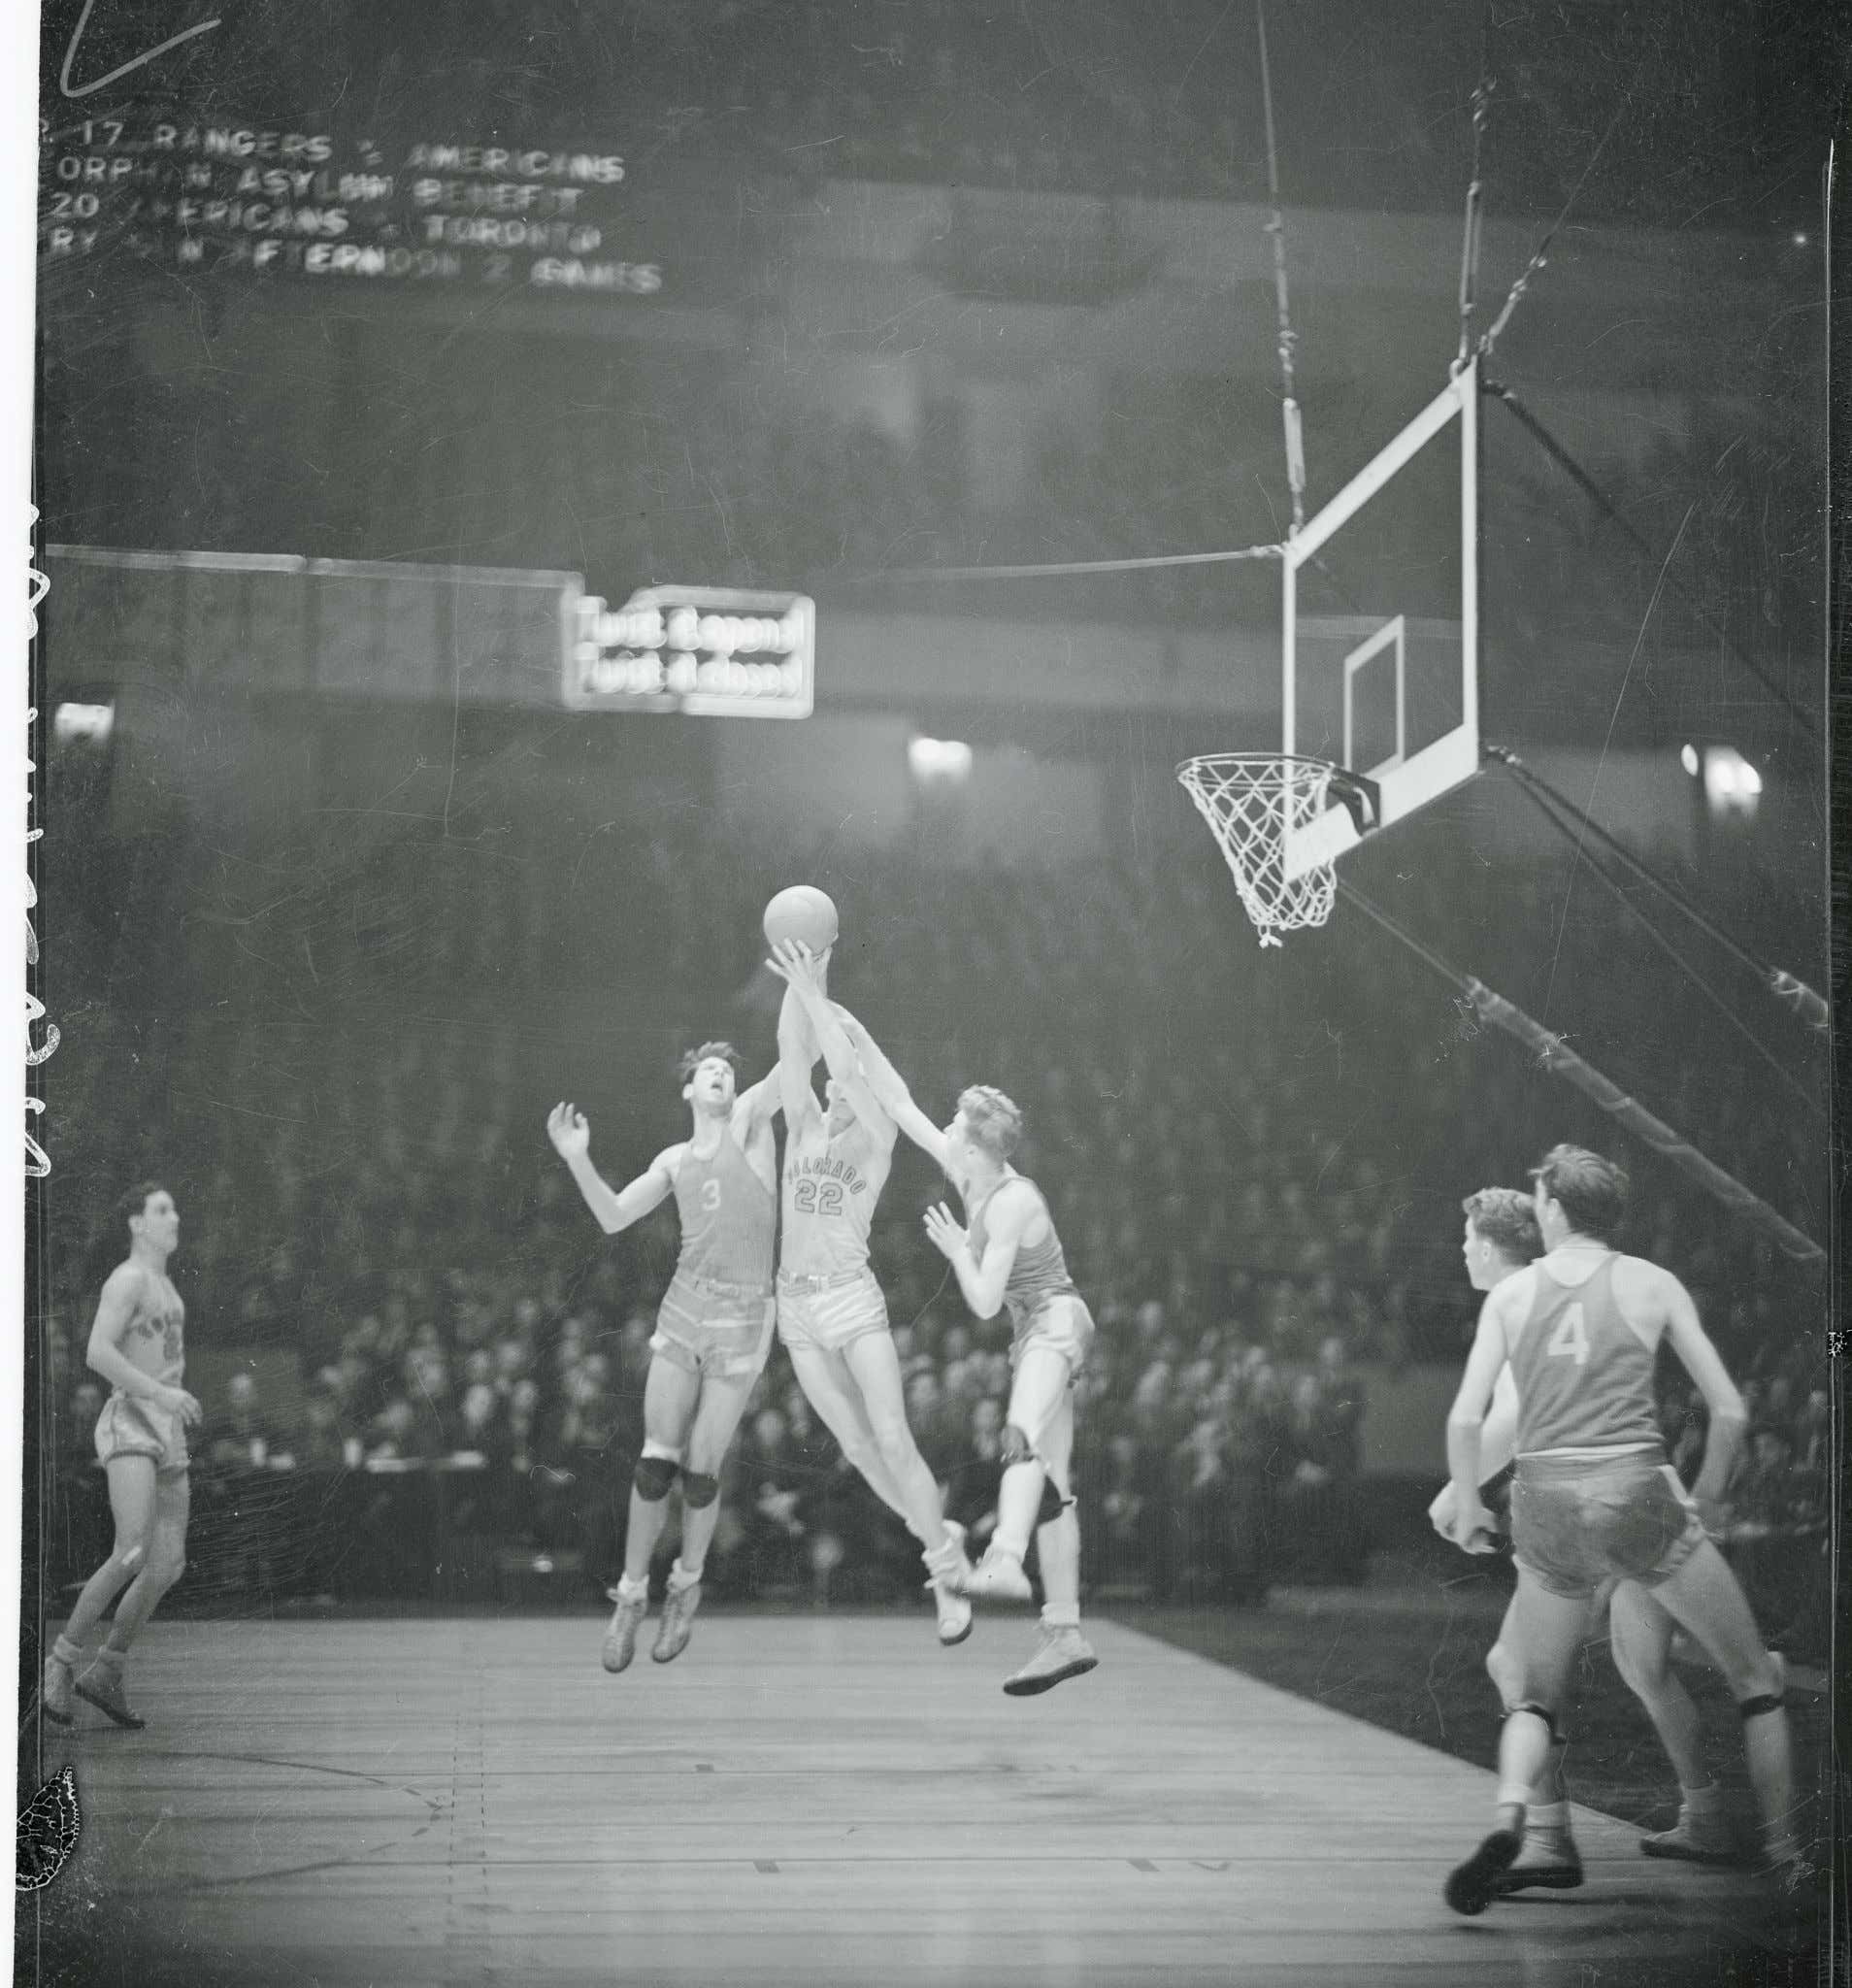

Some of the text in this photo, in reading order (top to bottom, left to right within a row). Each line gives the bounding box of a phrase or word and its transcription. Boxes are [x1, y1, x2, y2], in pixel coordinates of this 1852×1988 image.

[83, 119, 123, 146] 17
[153, 123, 333, 163] RANGERS
[58, 156, 212, 188] ORPHN
[50, 192, 99, 218] 20
[127, 196, 349, 238] ERICANS
[700, 1177, 721, 1211] 3
[794, 1177, 843, 1217] 22
[1546, 1301, 1591, 1366] 4
